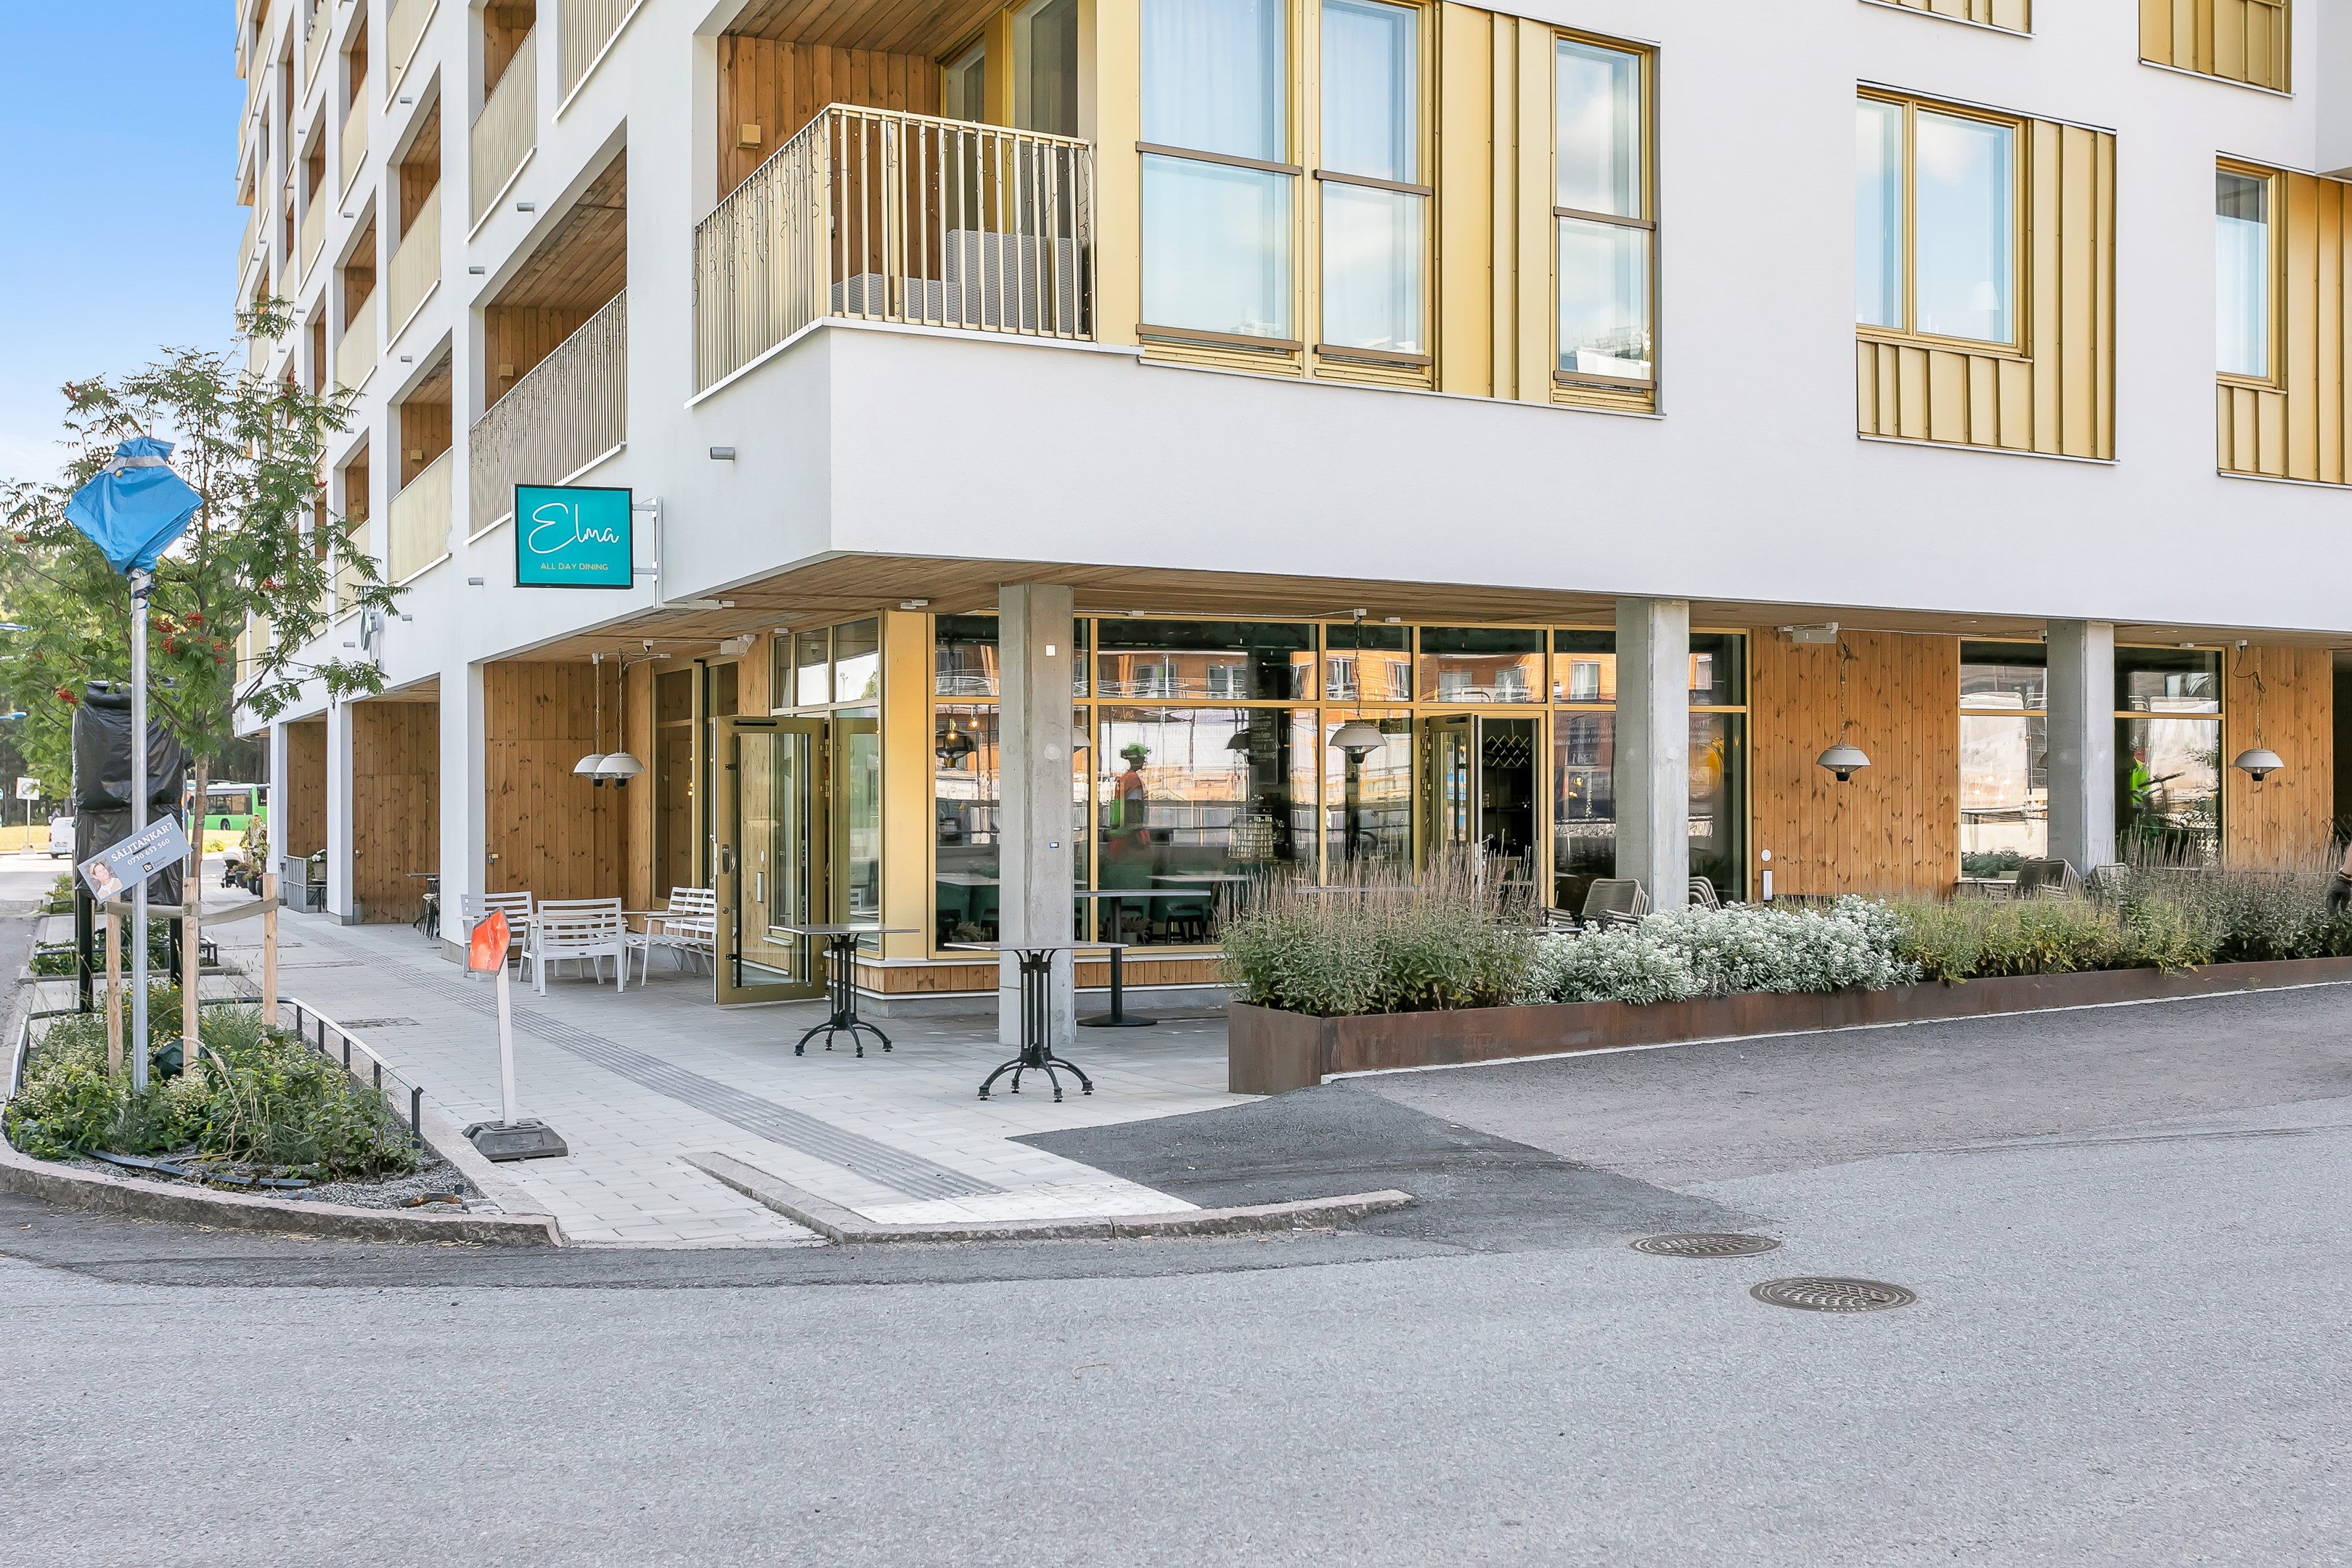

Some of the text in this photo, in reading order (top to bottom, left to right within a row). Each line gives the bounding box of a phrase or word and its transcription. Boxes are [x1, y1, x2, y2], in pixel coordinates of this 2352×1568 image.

[528, 502, 620, 554] Elma
[111, 822, 173, 862] SÄLJTANKAR?
[127, 853, 144, 865] 0730
[145, 847, 157, 856] 653
[158, 838, 170, 849] 560
